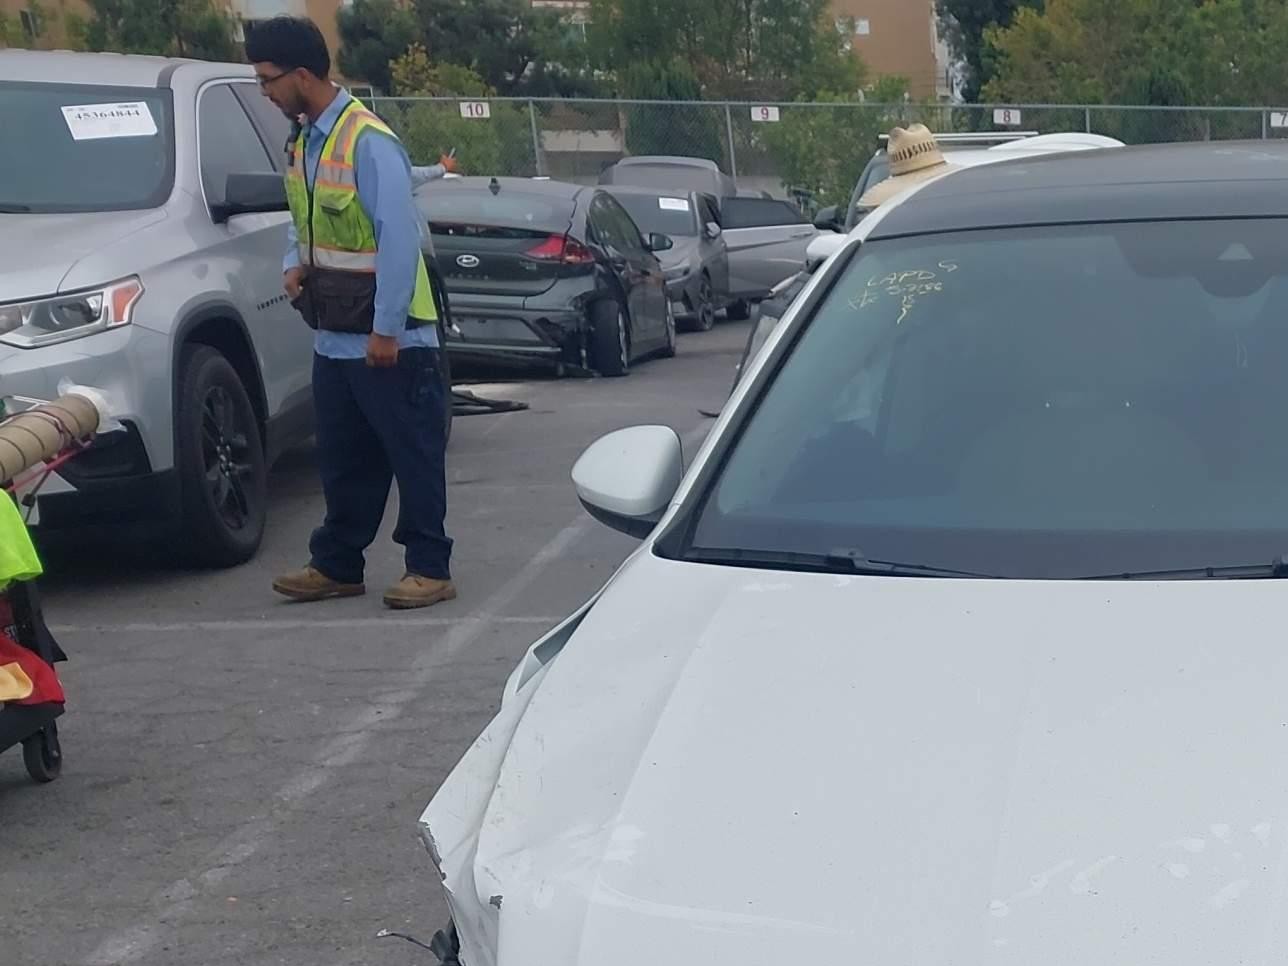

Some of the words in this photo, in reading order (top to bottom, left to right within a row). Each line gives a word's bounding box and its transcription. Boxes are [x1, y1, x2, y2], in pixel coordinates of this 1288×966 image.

[467, 103, 484, 116] 10
[761, 107, 769, 119] 9
[1004, 110, 1011, 122] 8
[1280, 112, 1288, 125] 7
